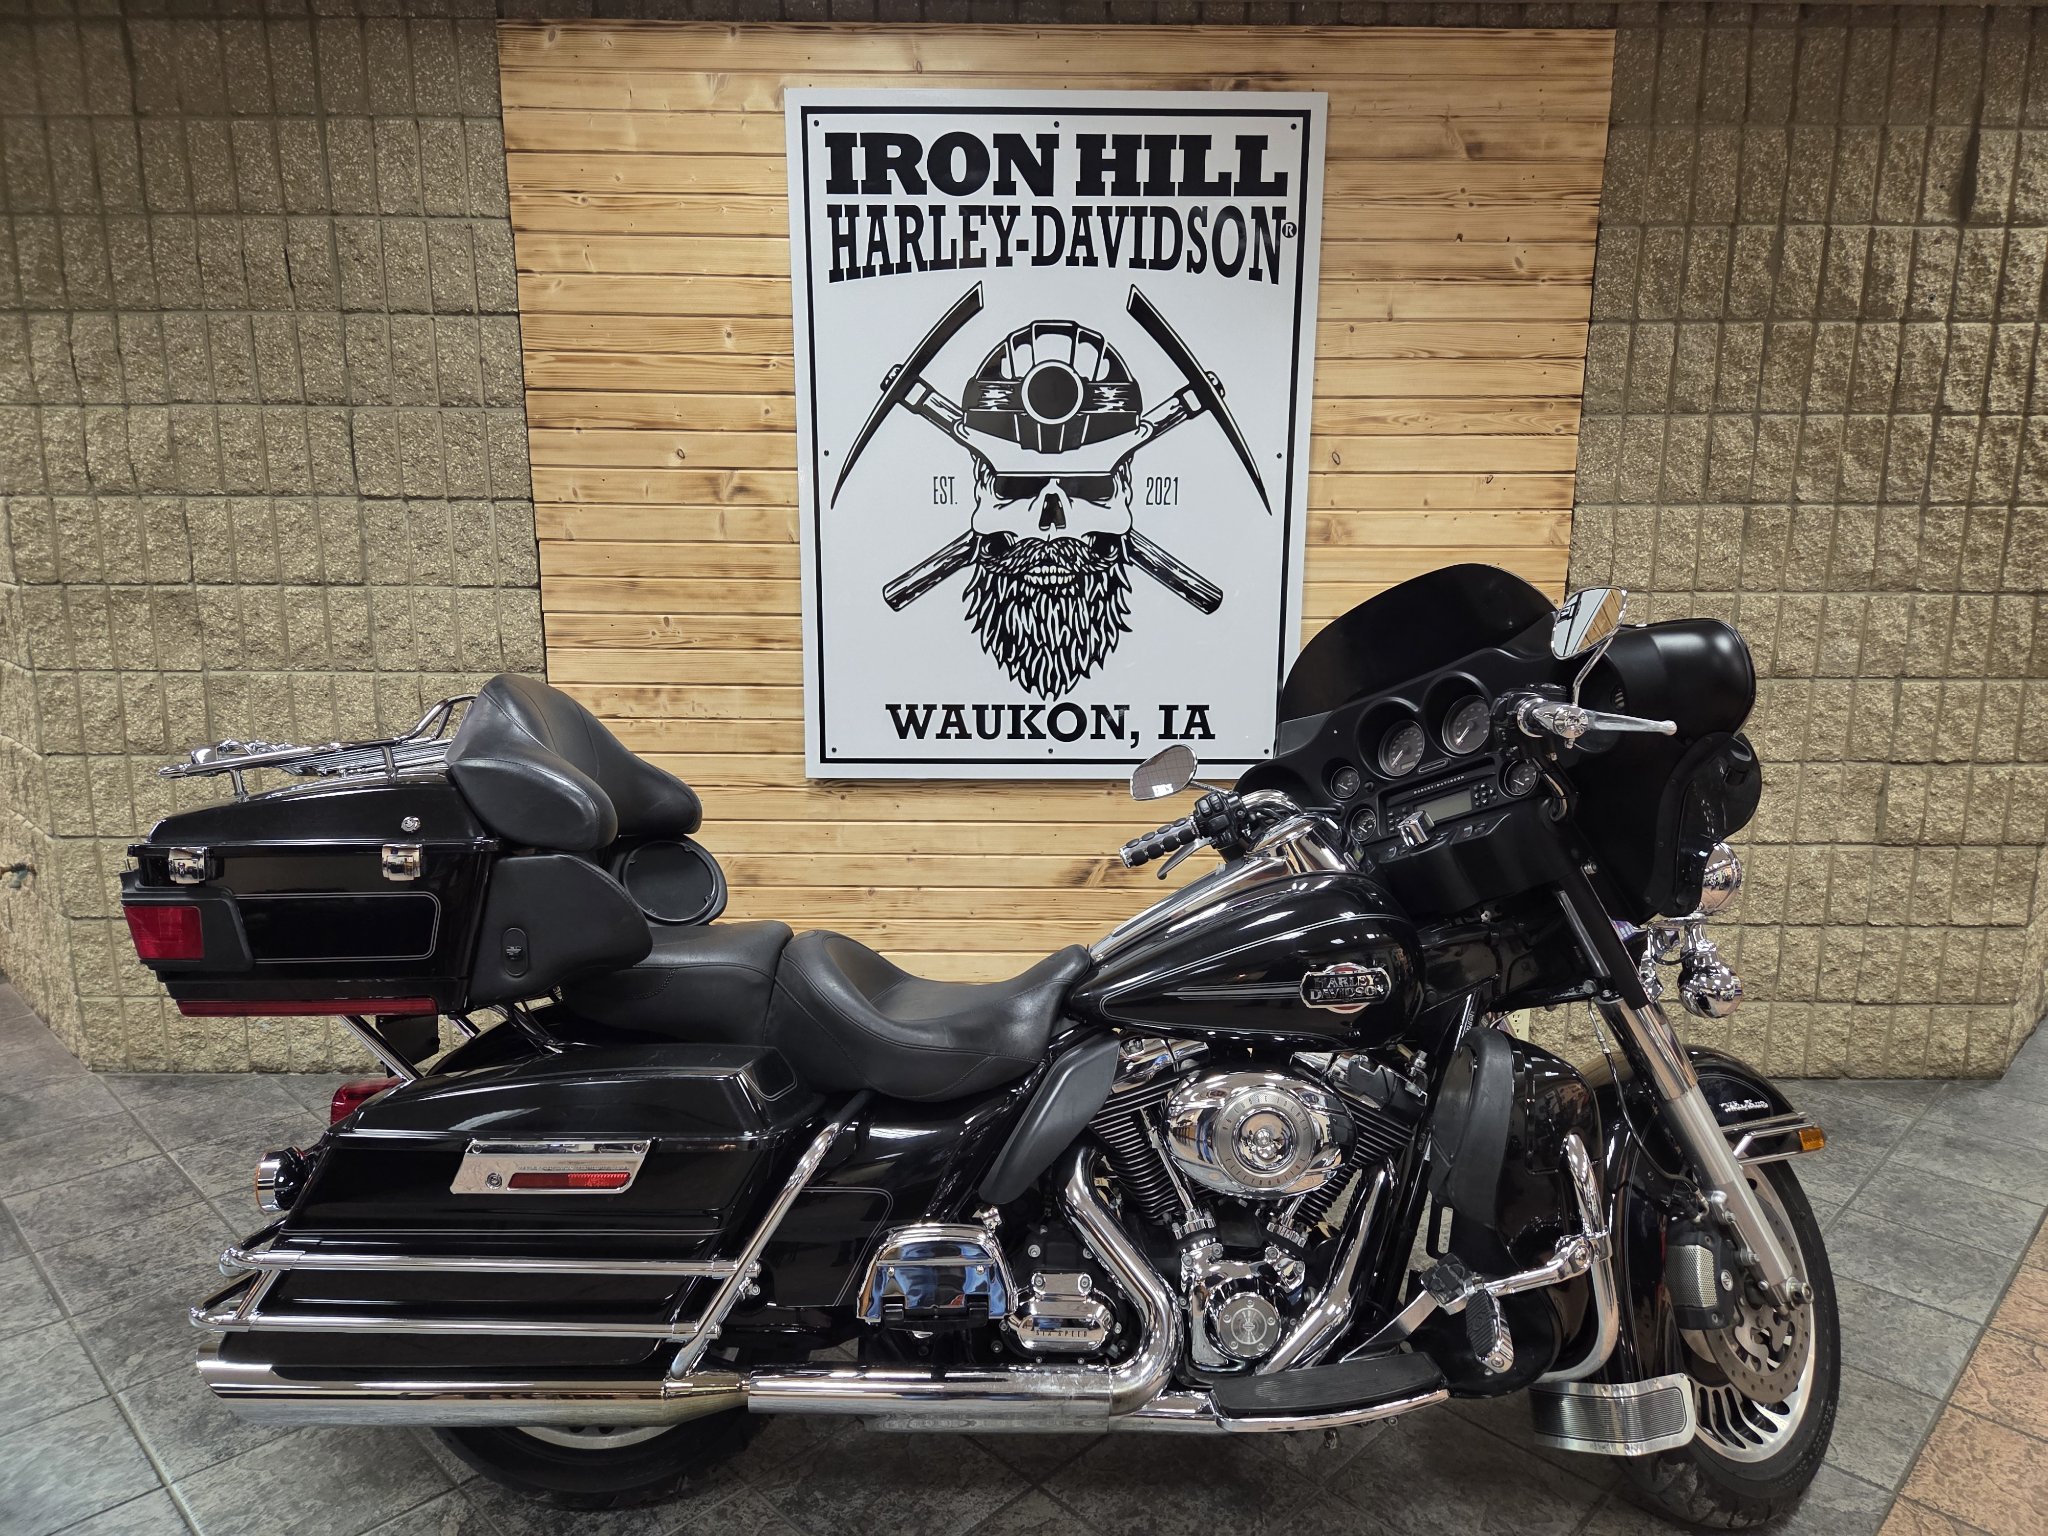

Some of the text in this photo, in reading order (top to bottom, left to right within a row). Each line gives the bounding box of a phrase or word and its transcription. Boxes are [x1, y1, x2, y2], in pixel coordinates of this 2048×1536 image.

[824, 132, 1289, 197] IRON HILL
[933, 475, 1180, 506] EST. 2021
[885, 701, 1216, 749] WAUKON, IA
